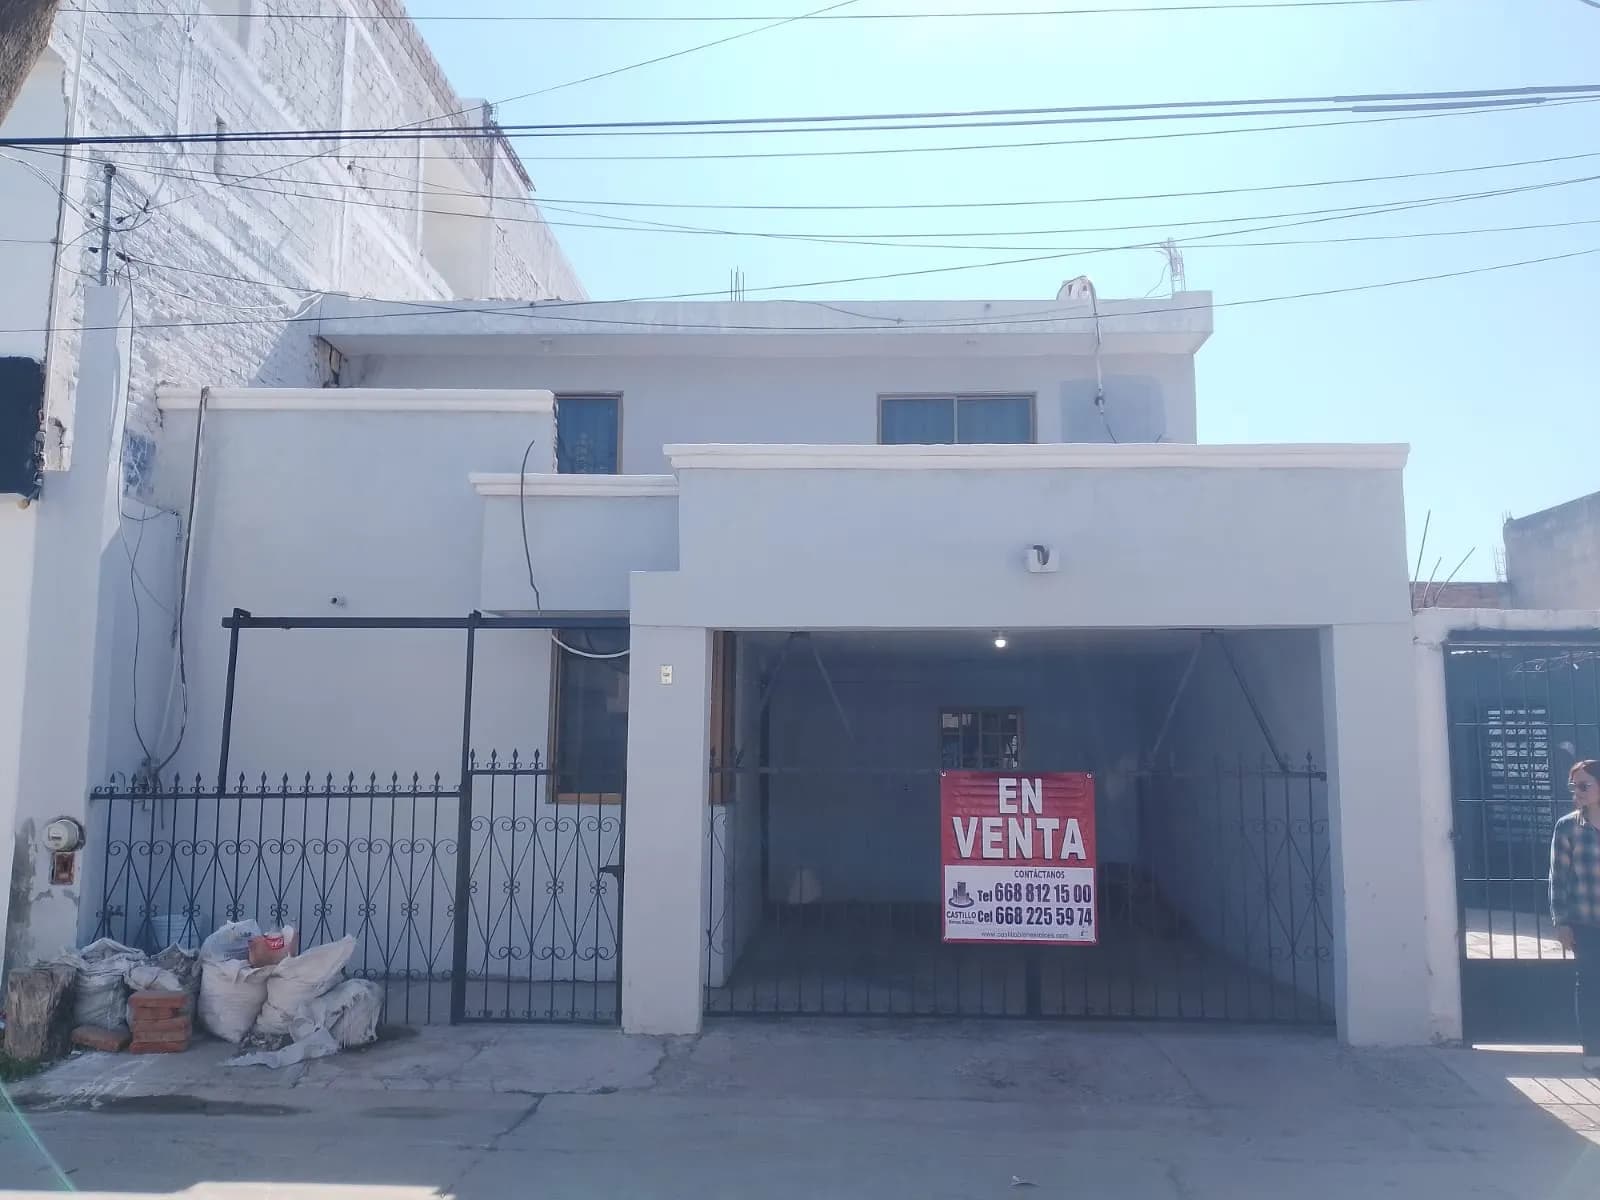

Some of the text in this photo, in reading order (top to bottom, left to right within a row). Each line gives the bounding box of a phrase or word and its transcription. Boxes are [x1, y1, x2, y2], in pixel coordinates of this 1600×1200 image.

[998, 778, 1043, 814] EN
[952, 816, 1087, 860] VENTA
[1014, 869, 1065, 879] CONTÁCTANOS
[977, 882, 1092, 903] Tel 668 812 15 00
[946, 910, 977, 919] CASTILLO
[977, 906, 1093, 926] Cel 668 225 59 74
